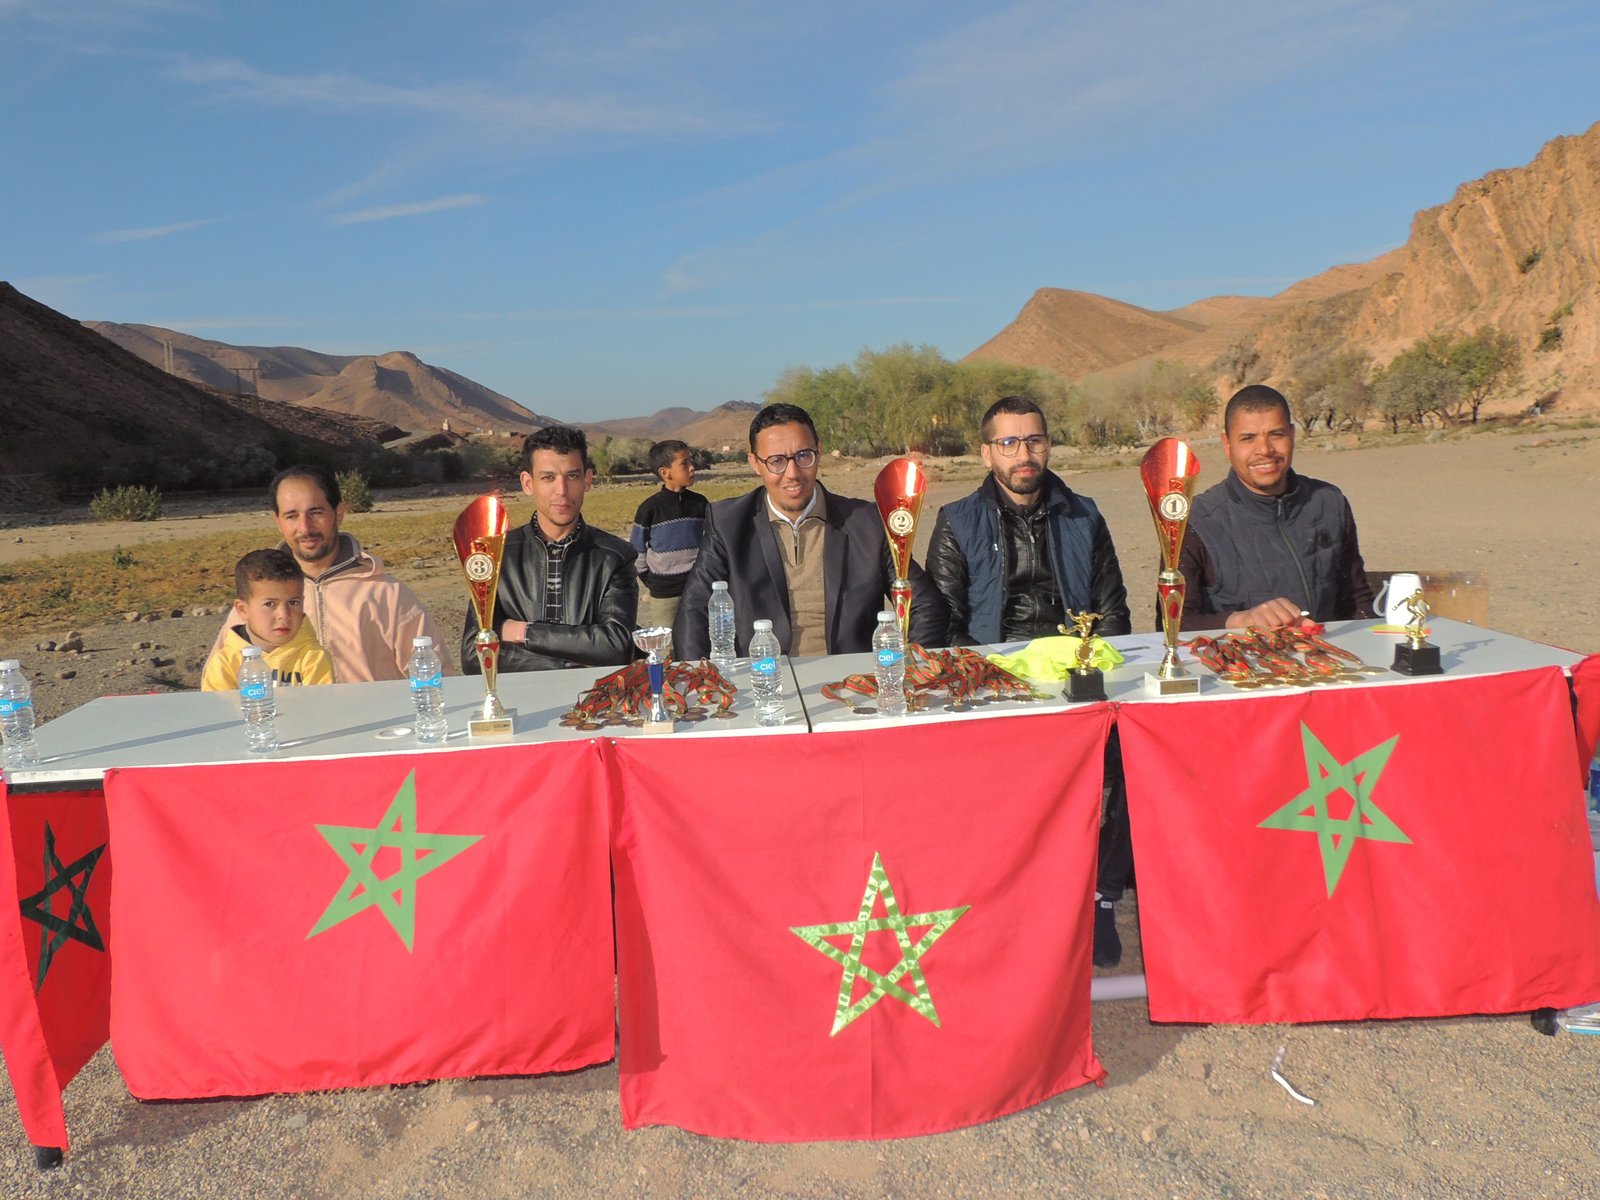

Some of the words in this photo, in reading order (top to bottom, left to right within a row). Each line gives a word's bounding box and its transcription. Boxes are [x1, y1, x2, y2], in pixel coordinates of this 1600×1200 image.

[1170, 499, 1178, 513] 1
[897, 515, 907, 527] 2
[473, 560, 485, 574] 3
